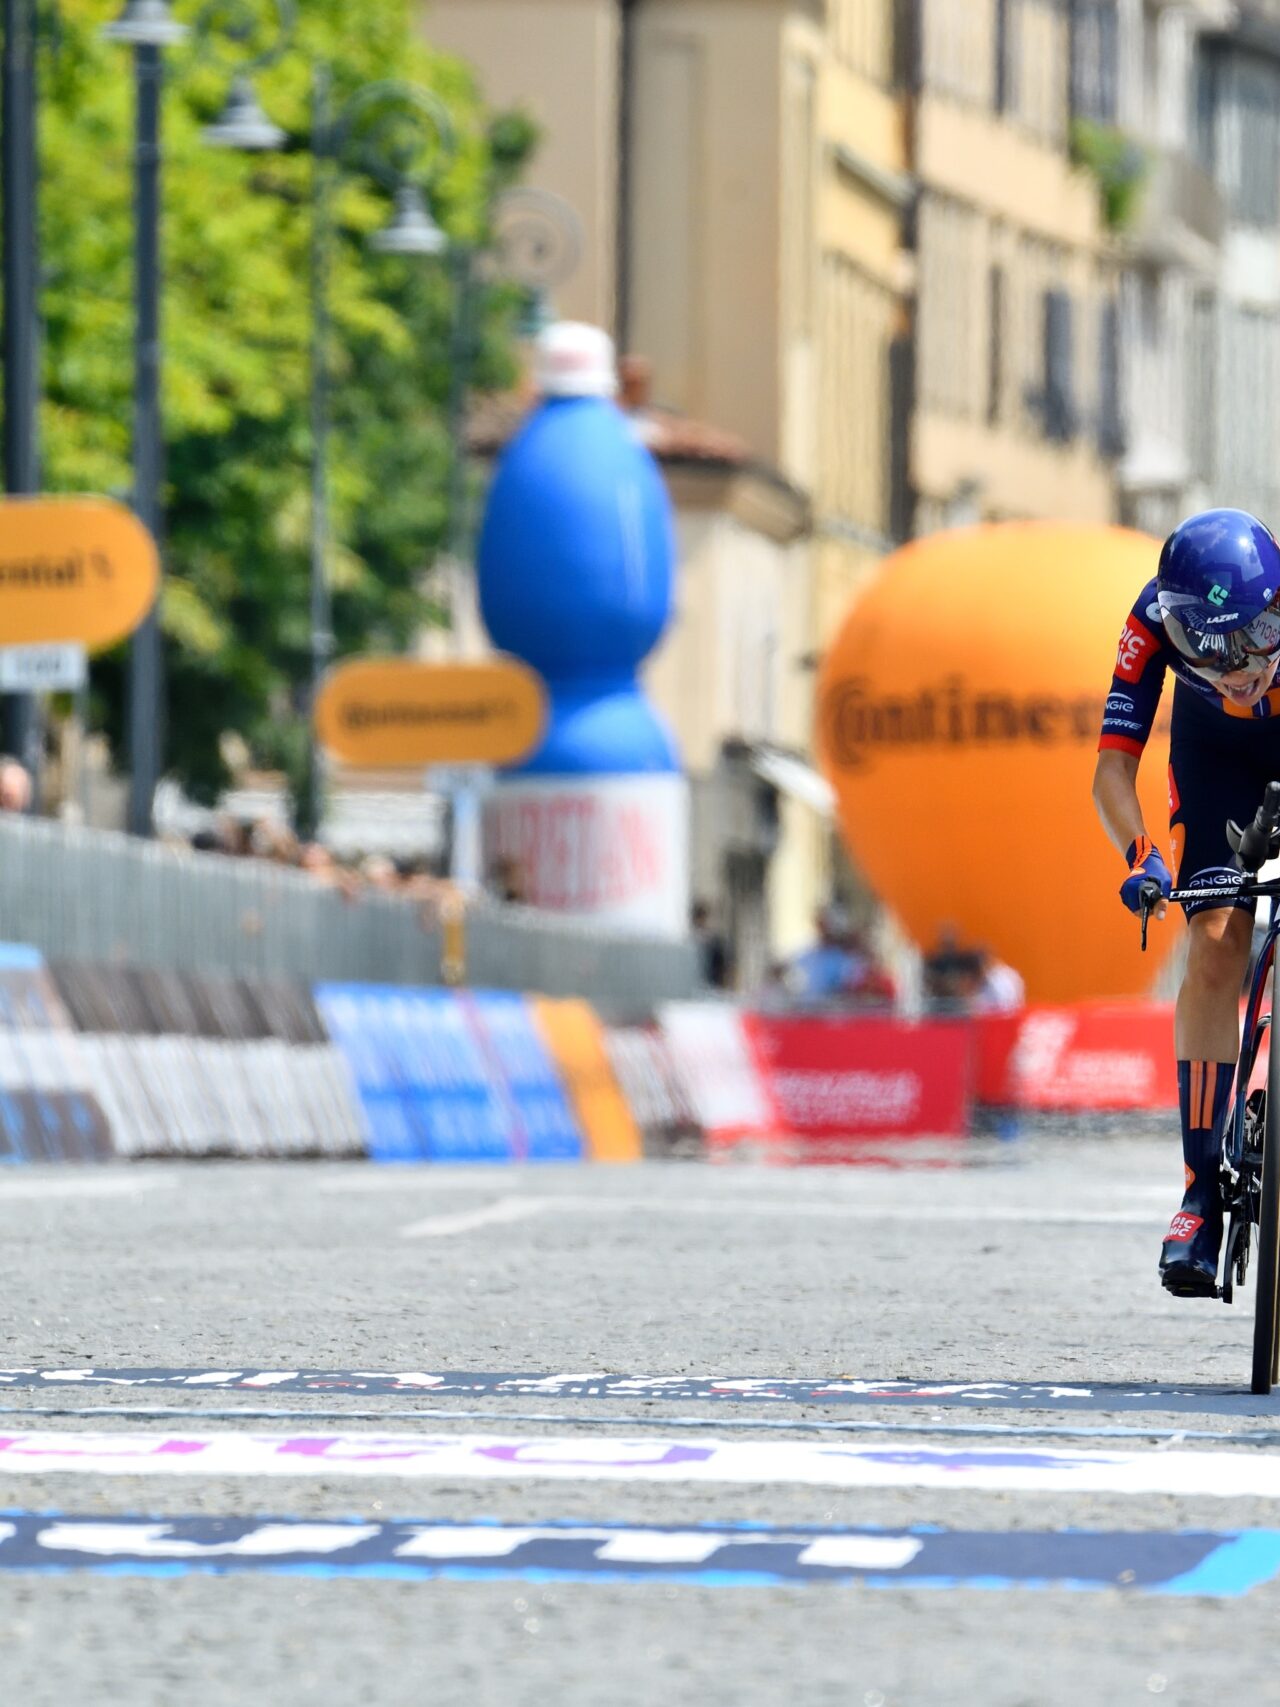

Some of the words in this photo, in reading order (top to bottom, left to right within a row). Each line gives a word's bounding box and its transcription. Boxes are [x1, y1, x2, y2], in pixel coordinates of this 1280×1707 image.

[1206, 612, 1239, 624] LAZER
[1169, 886, 1240, 899] LAPIERRE
[1172, 1216, 1196, 1229] PIC
[0, 1521, 924, 1571] um
